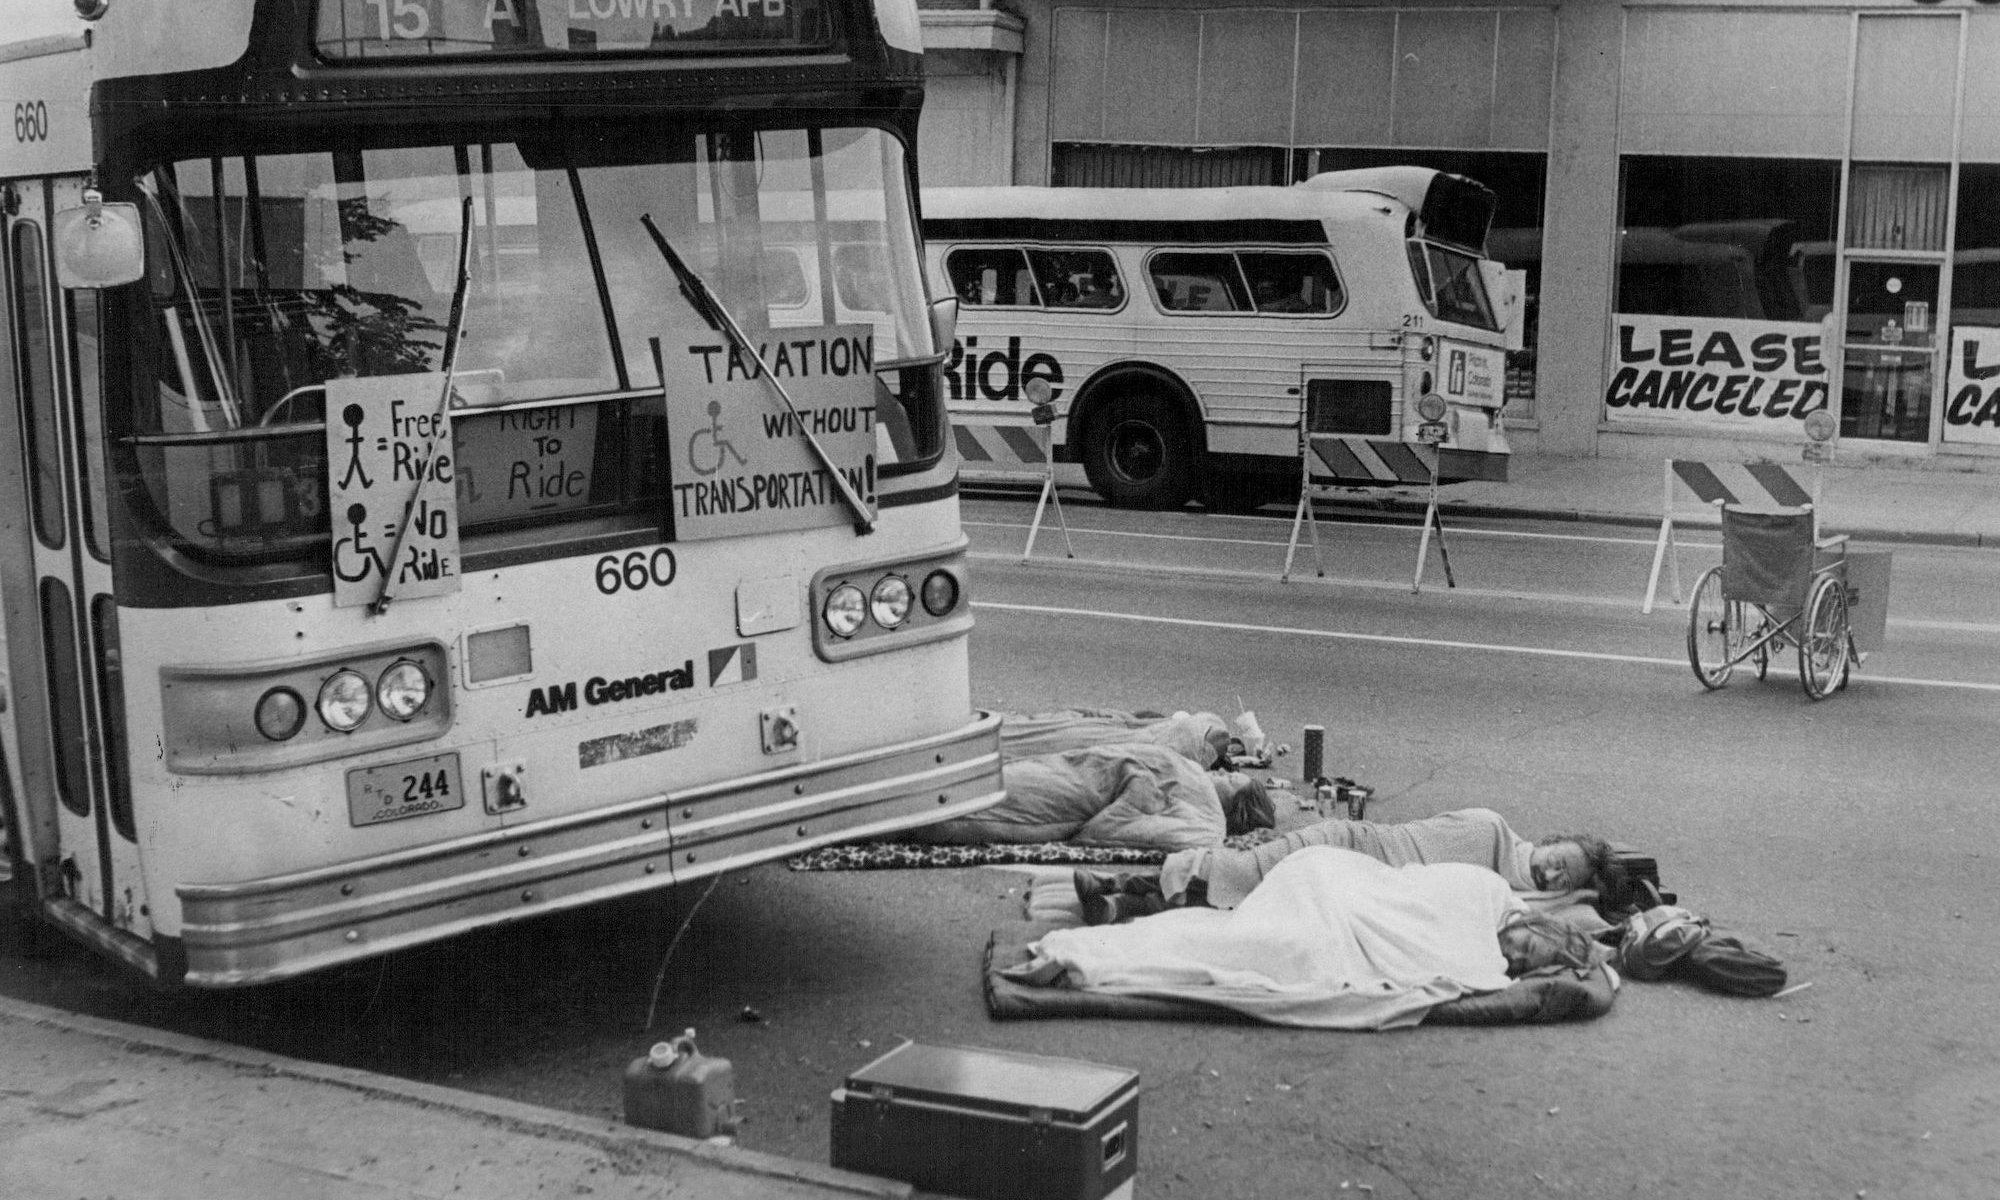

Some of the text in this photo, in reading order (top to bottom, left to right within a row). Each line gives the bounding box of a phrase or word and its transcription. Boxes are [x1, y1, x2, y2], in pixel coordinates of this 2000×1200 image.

[366, 0, 429, 39] 15
[484, 0, 521, 28] A
[14, 100, 48, 142] 660
[1402, 314, 1424, 328] 211
[1619, 325, 1827, 375] LEASE
[1606, 366, 1829, 420] CANCELED
[391, 400, 447, 439] Free
[500, 406, 576, 432] RIGHT
[763, 406, 876, 438] WITHOUT
[392, 440, 453, 483] Ride
[507, 460, 586, 499] Ride
[595, 547, 677, 595] 660
[525, 660, 695, 718] AM General
[402, 768, 450, 802] 244
